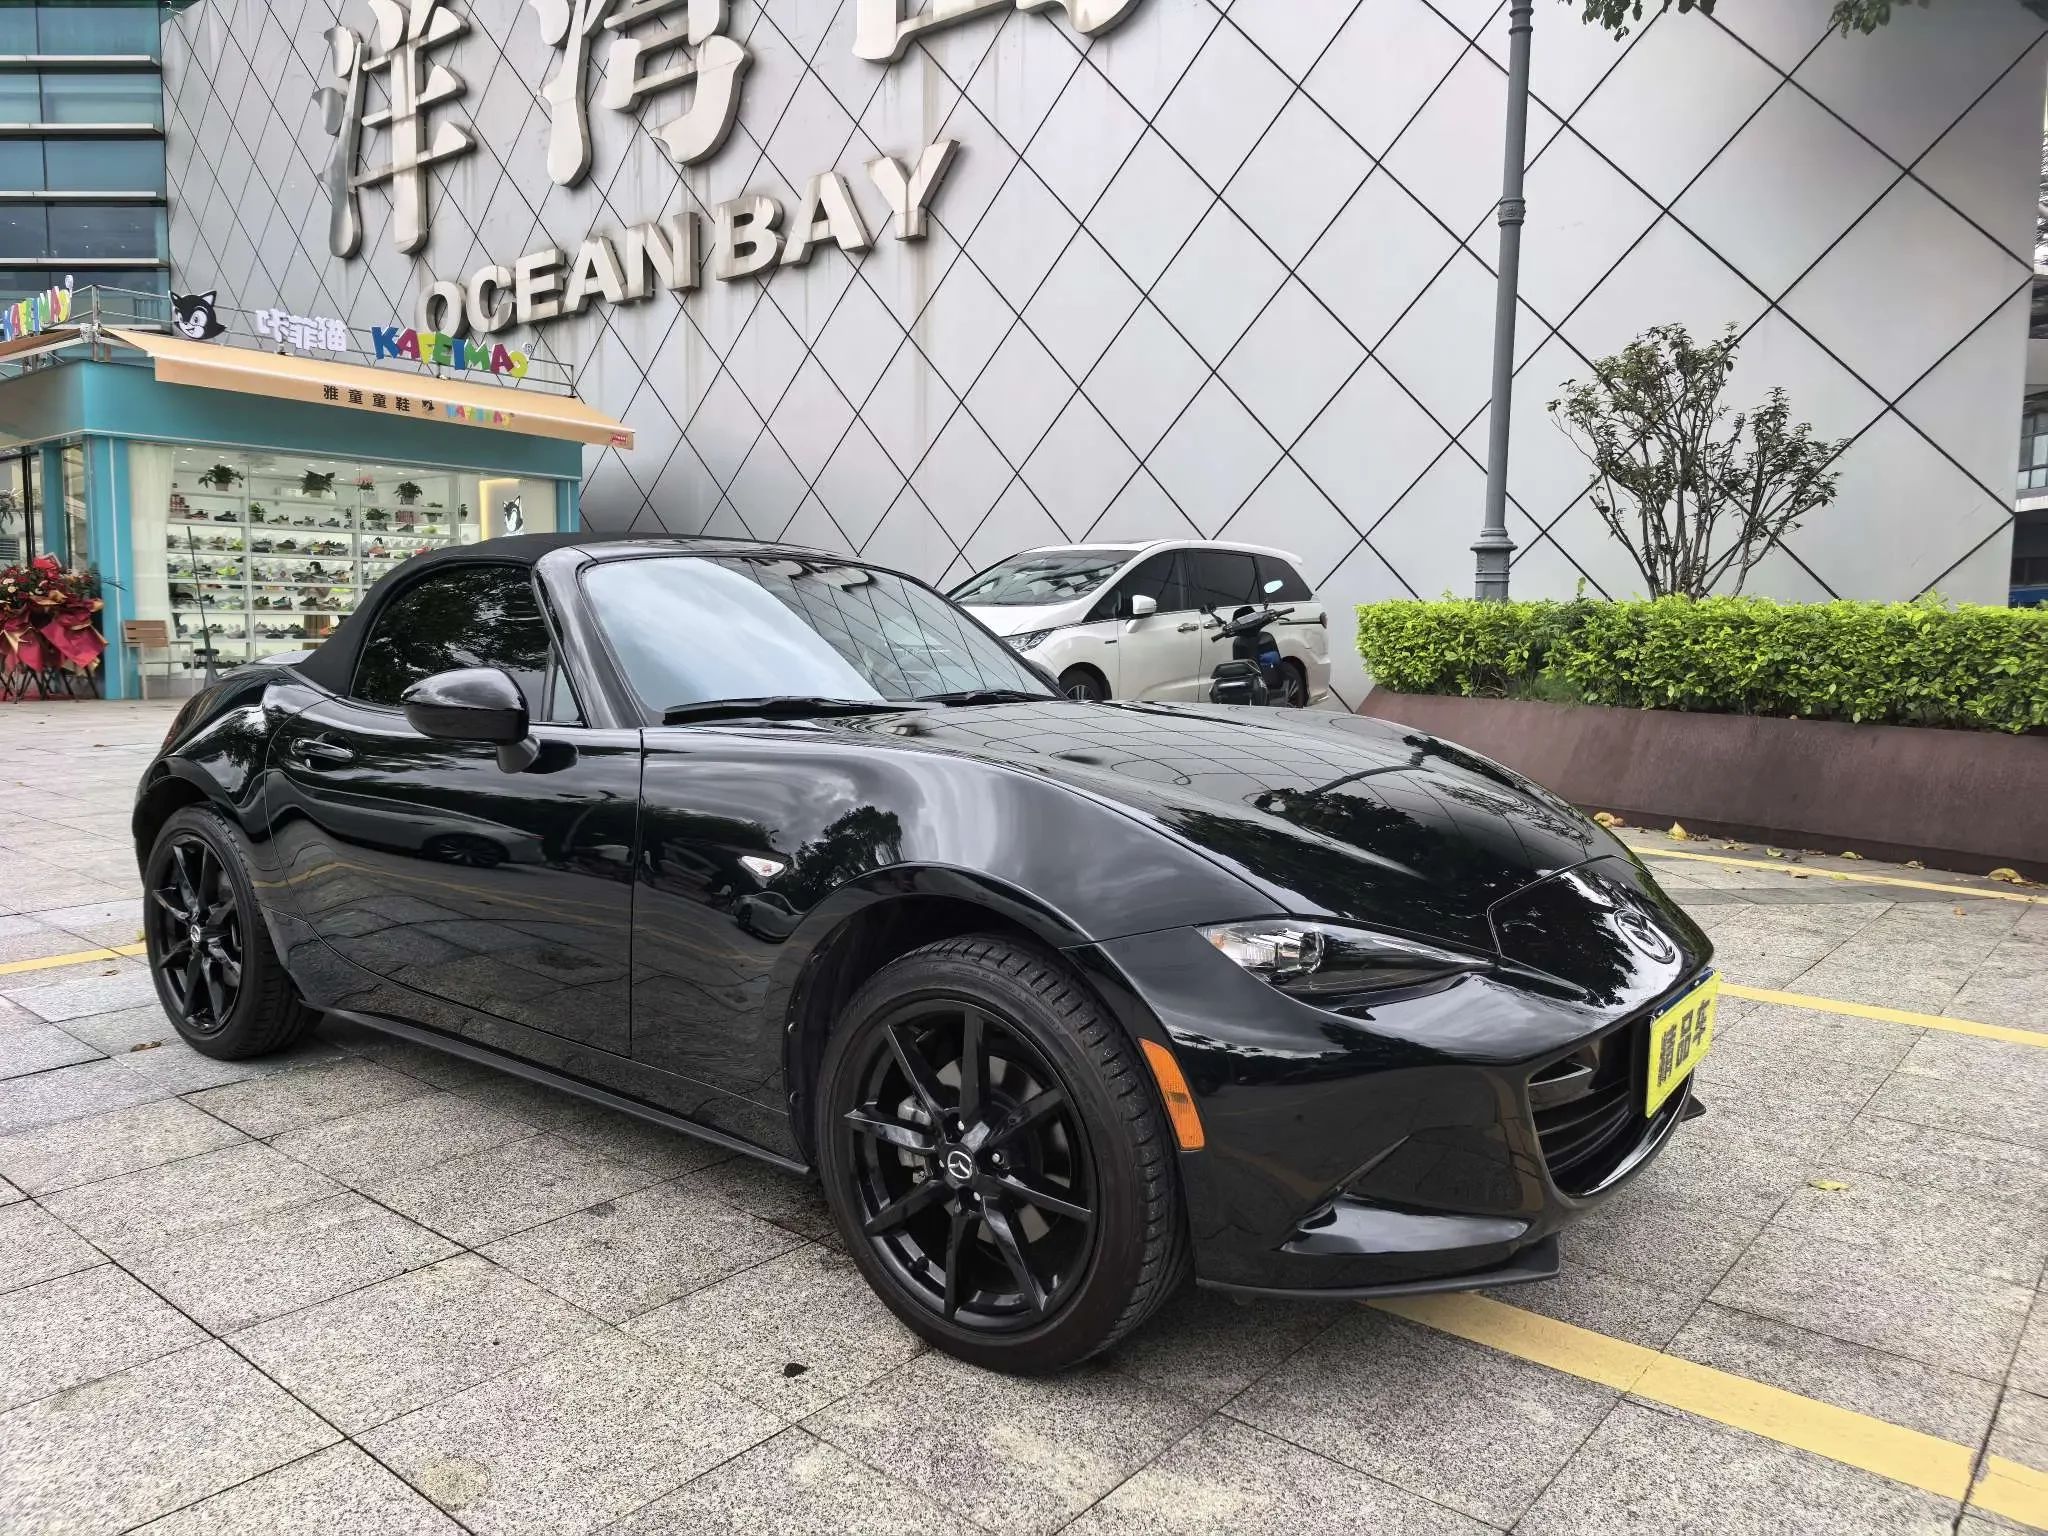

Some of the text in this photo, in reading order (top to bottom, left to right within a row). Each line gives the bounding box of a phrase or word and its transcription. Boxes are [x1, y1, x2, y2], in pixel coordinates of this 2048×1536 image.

[414, 139, 961, 337] OCEAN BAY
[255, 308, 347, 351] 咔菲猫
[371, 326, 529, 378] KAFEIMAO
[323, 384, 411, 412] 雅童童鞋
